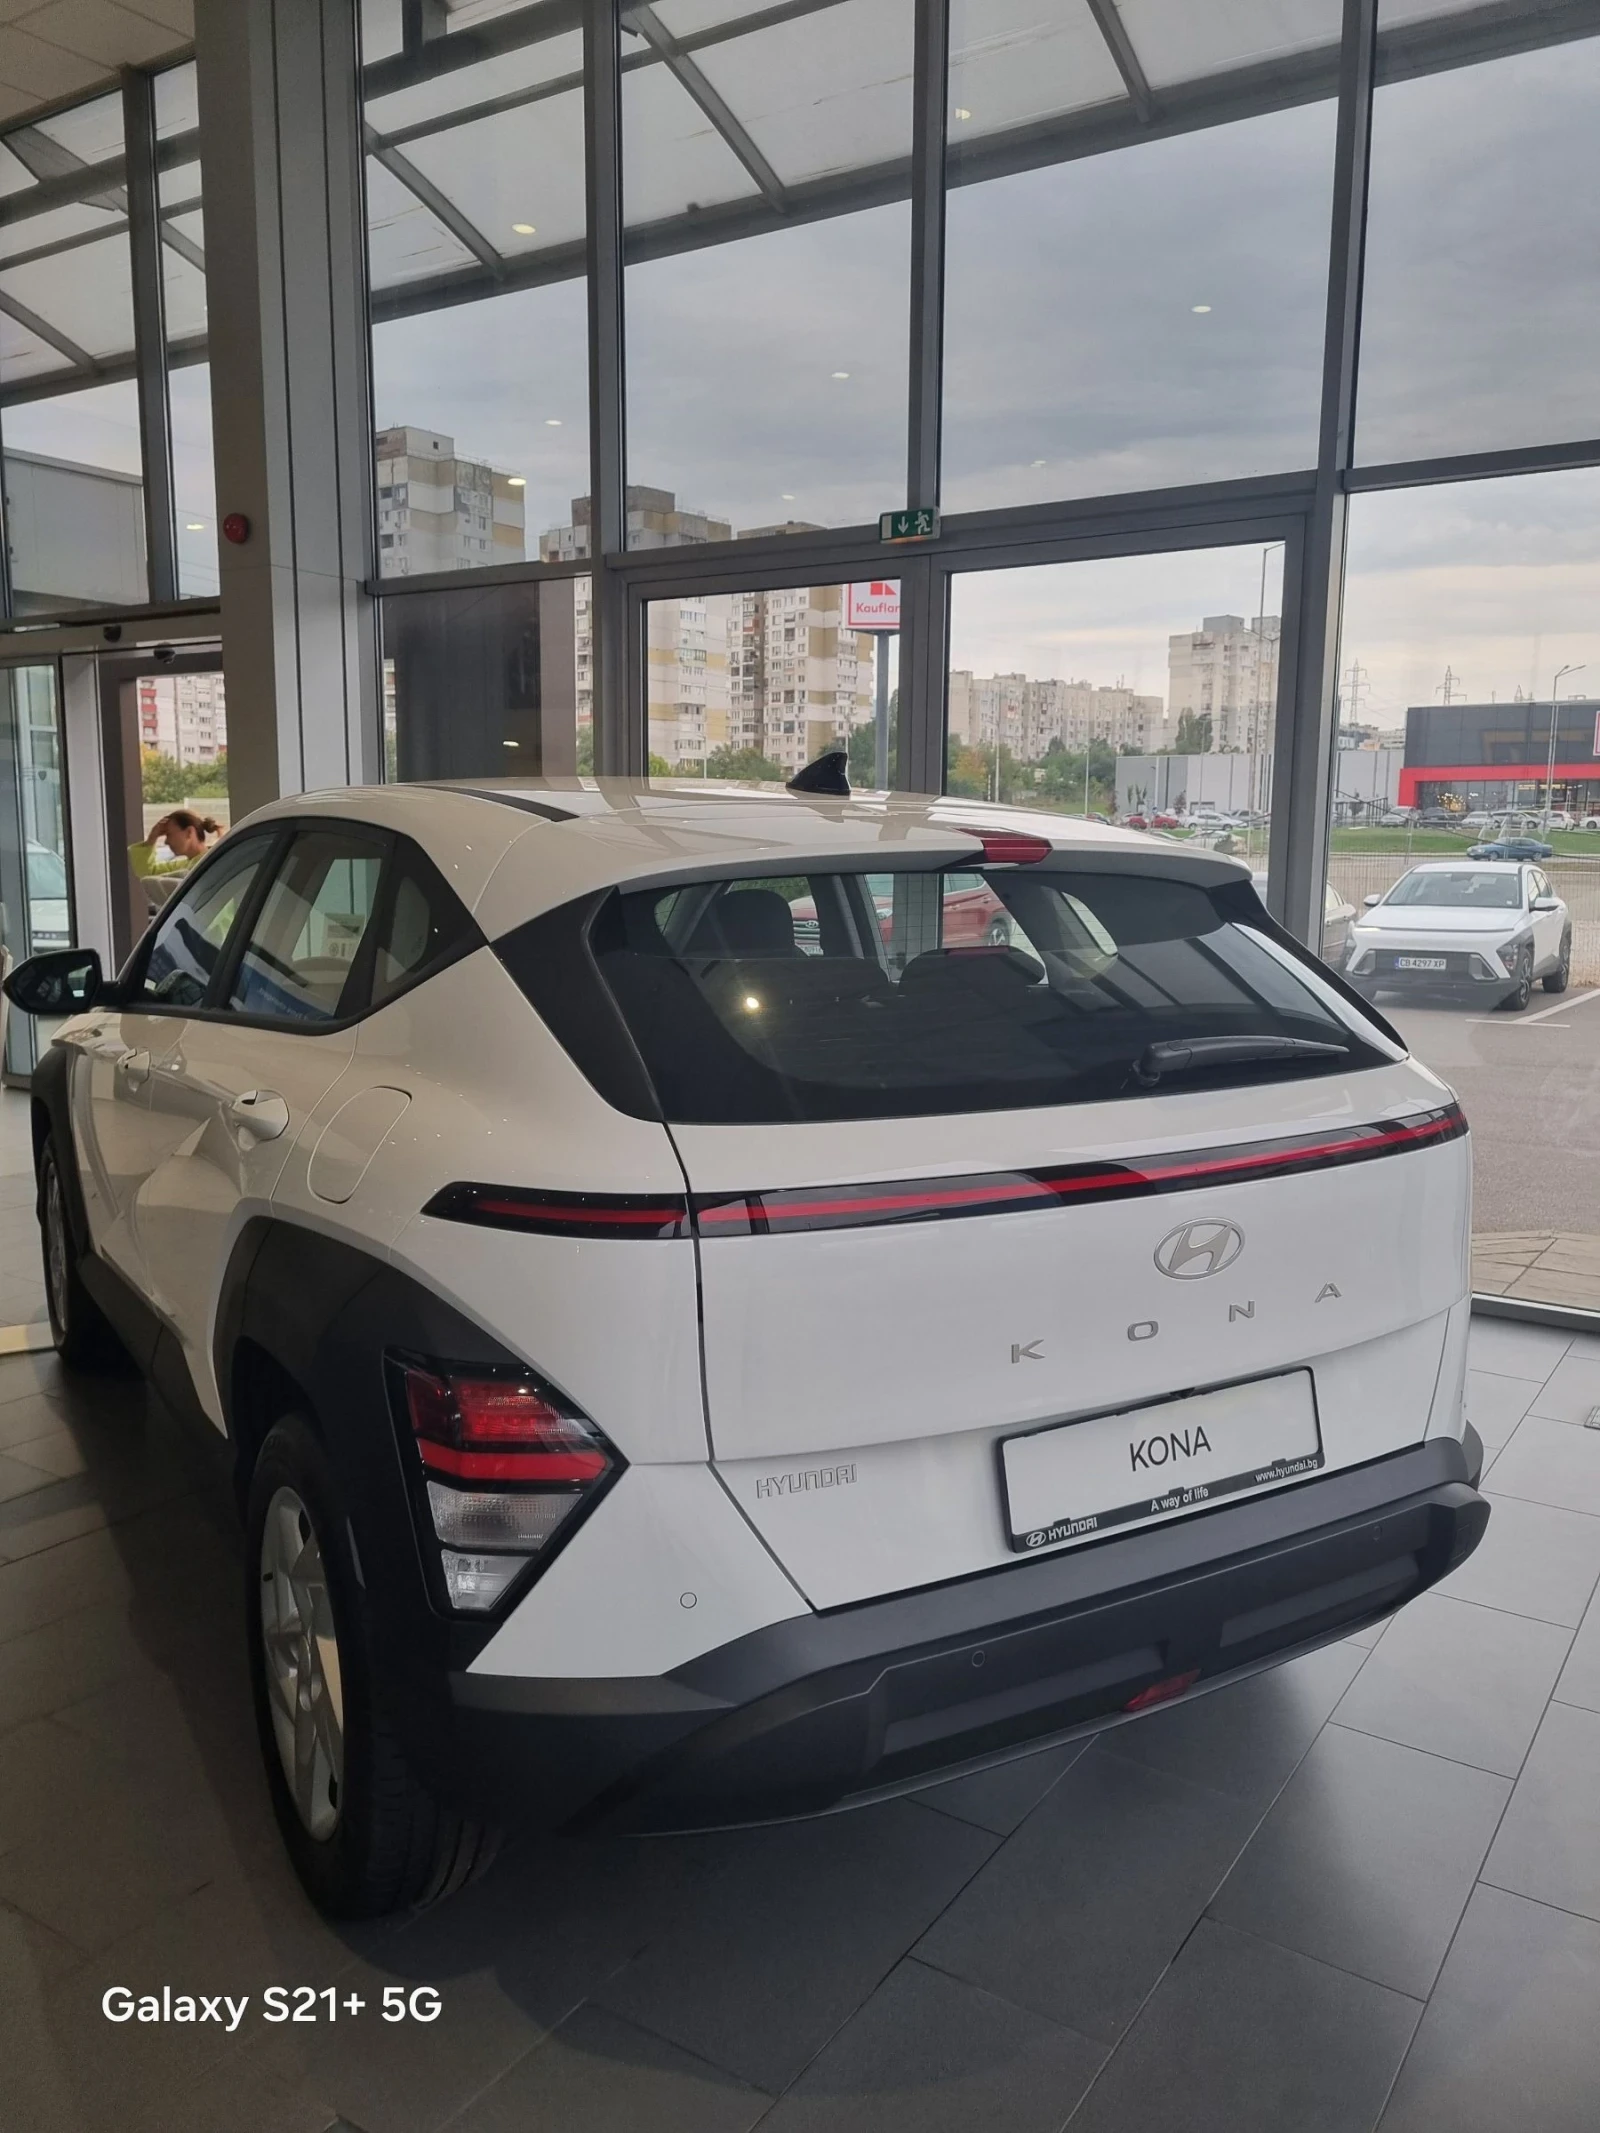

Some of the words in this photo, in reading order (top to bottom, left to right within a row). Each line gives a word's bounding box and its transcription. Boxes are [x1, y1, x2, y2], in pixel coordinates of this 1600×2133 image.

[856, 602, 901, 613] Kauflan
[1011, 1281, 1342, 1363] KONA
[1129, 1425, 1212, 1472] KONA
[756, 1463, 858, 1499] HYUNDAI
[1255, 1459, 1318, 1482] www.hyundai.bg
[1150, 1499, 1160, 1512] A
[1160, 1494, 1181, 1509] way
[1182, 1491, 1194, 1503] of
[1194, 1486, 1209, 1500] life
[1048, 1516, 1098, 1541] HYUNDAI
